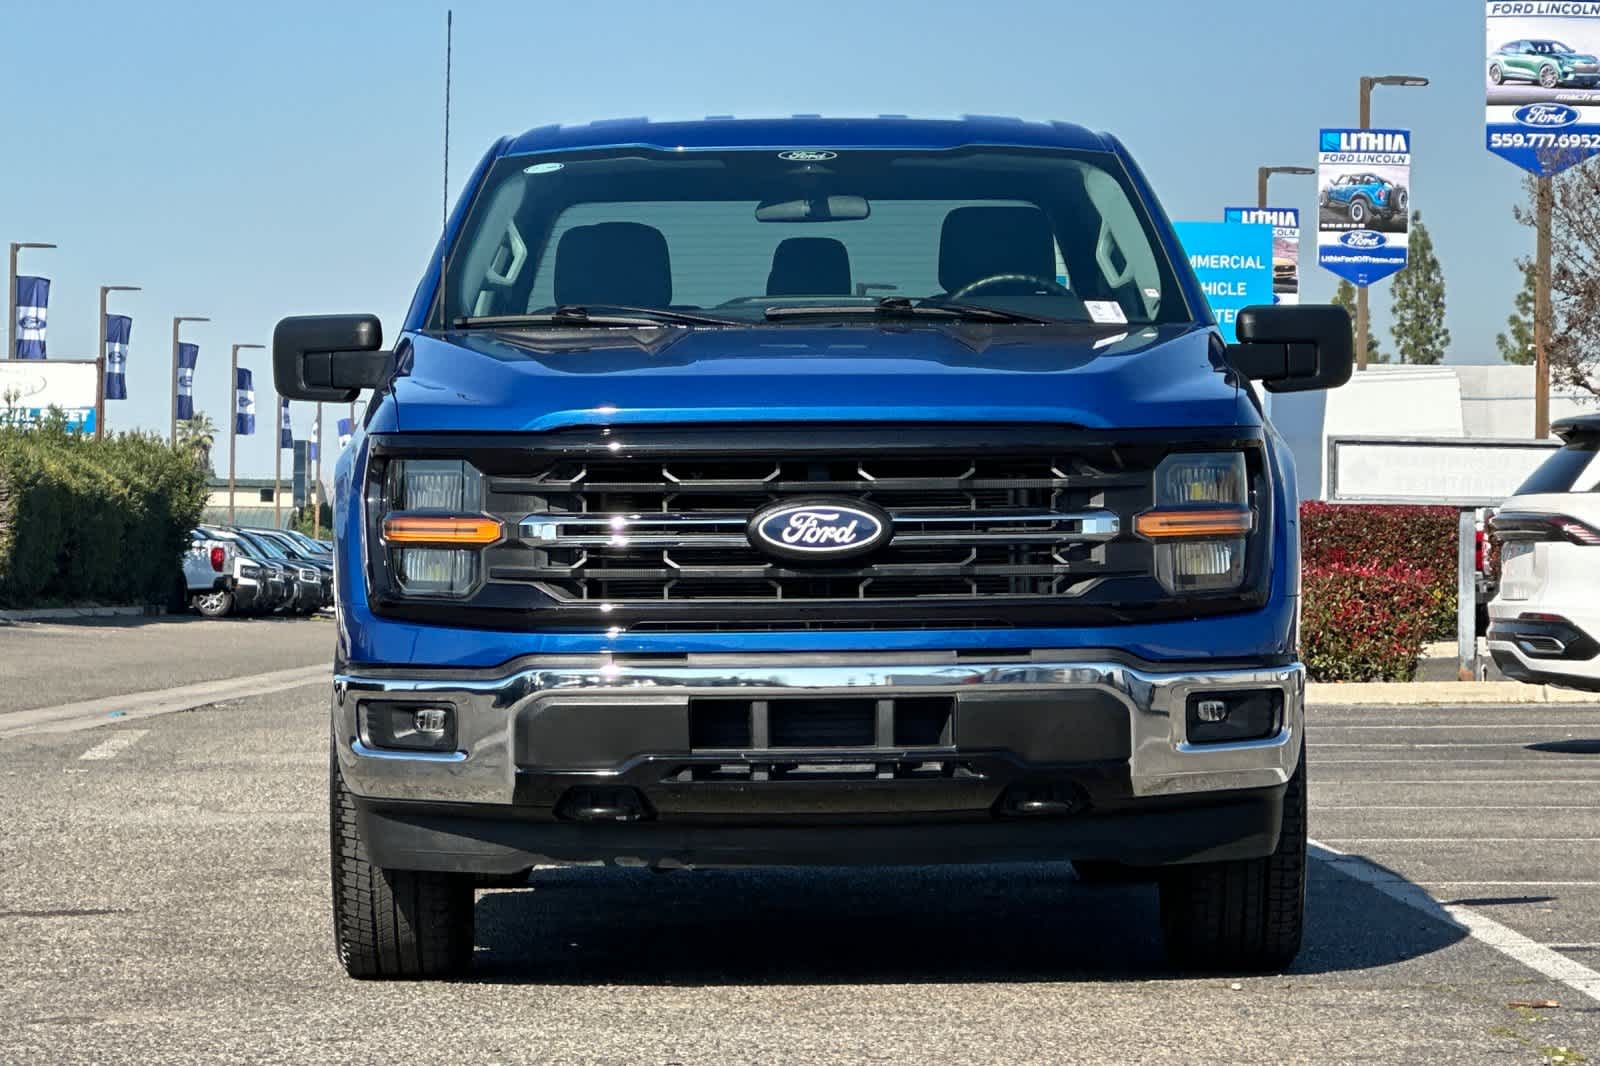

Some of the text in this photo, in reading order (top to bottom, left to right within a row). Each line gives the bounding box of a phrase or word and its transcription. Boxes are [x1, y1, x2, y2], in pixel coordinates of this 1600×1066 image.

[1492, 3, 1600, 15] FORD LINCOLN
[1525, 105, 1568, 124] Ford
[1340, 132, 1407, 151] LITHIA
[1491, 133, 1600, 148] 559.777.6952
[1323, 154, 1406, 163] FORD LINCOLN
[1241, 210, 1297, 226] LITHIA
[1189, 255, 1265, 269] MMERCIAL
[1201, 282, 1247, 296] HICLE
[782, 511, 858, 543] Ford
